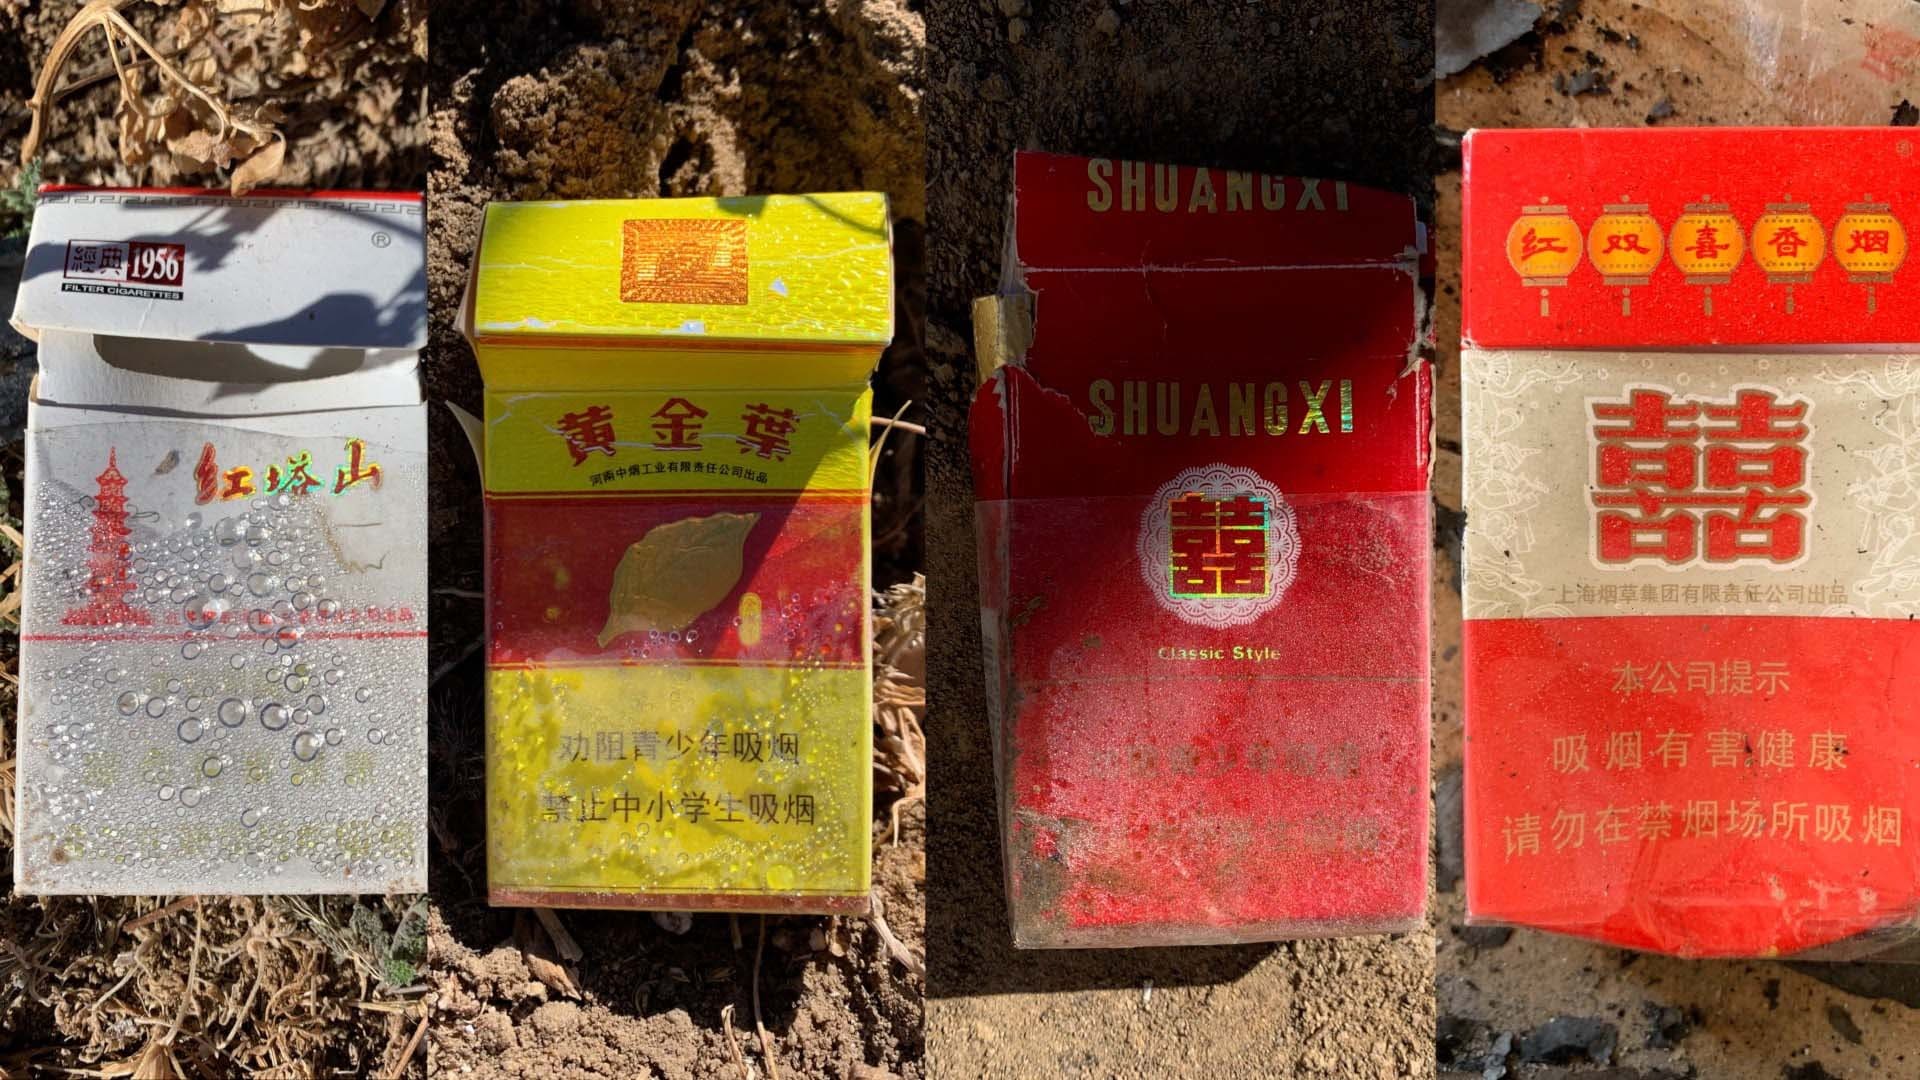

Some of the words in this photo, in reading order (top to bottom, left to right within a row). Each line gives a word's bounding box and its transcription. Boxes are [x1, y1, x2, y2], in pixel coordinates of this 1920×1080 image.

[1520, 225, 1892, 261] 红双喜香烟
[72, 246, 122, 275] 經典
[131, 247, 180, 281] 1956
[64, 283, 105, 294] FILTER
[107, 287, 180, 300] CIGARETTES
[1088, 379, 1353, 437] SHUANGXI
[1554, 583, 1849, 605] 上海烟草集团有限责任公司出品
[1157, 646, 1225, 661] Classic
[1232, 646, 1281, 662] Style
[1611, 661, 1791, 696] 本公司提示
[560, 728, 801, 767] 劝阻青少年吸烟
[1553, 729, 1848, 775] 吸烟有害健康
[541, 791, 817, 827] 禁止中小学生吸烟
[1501, 799, 1903, 863] 请勿在禁烟场所吸烟
